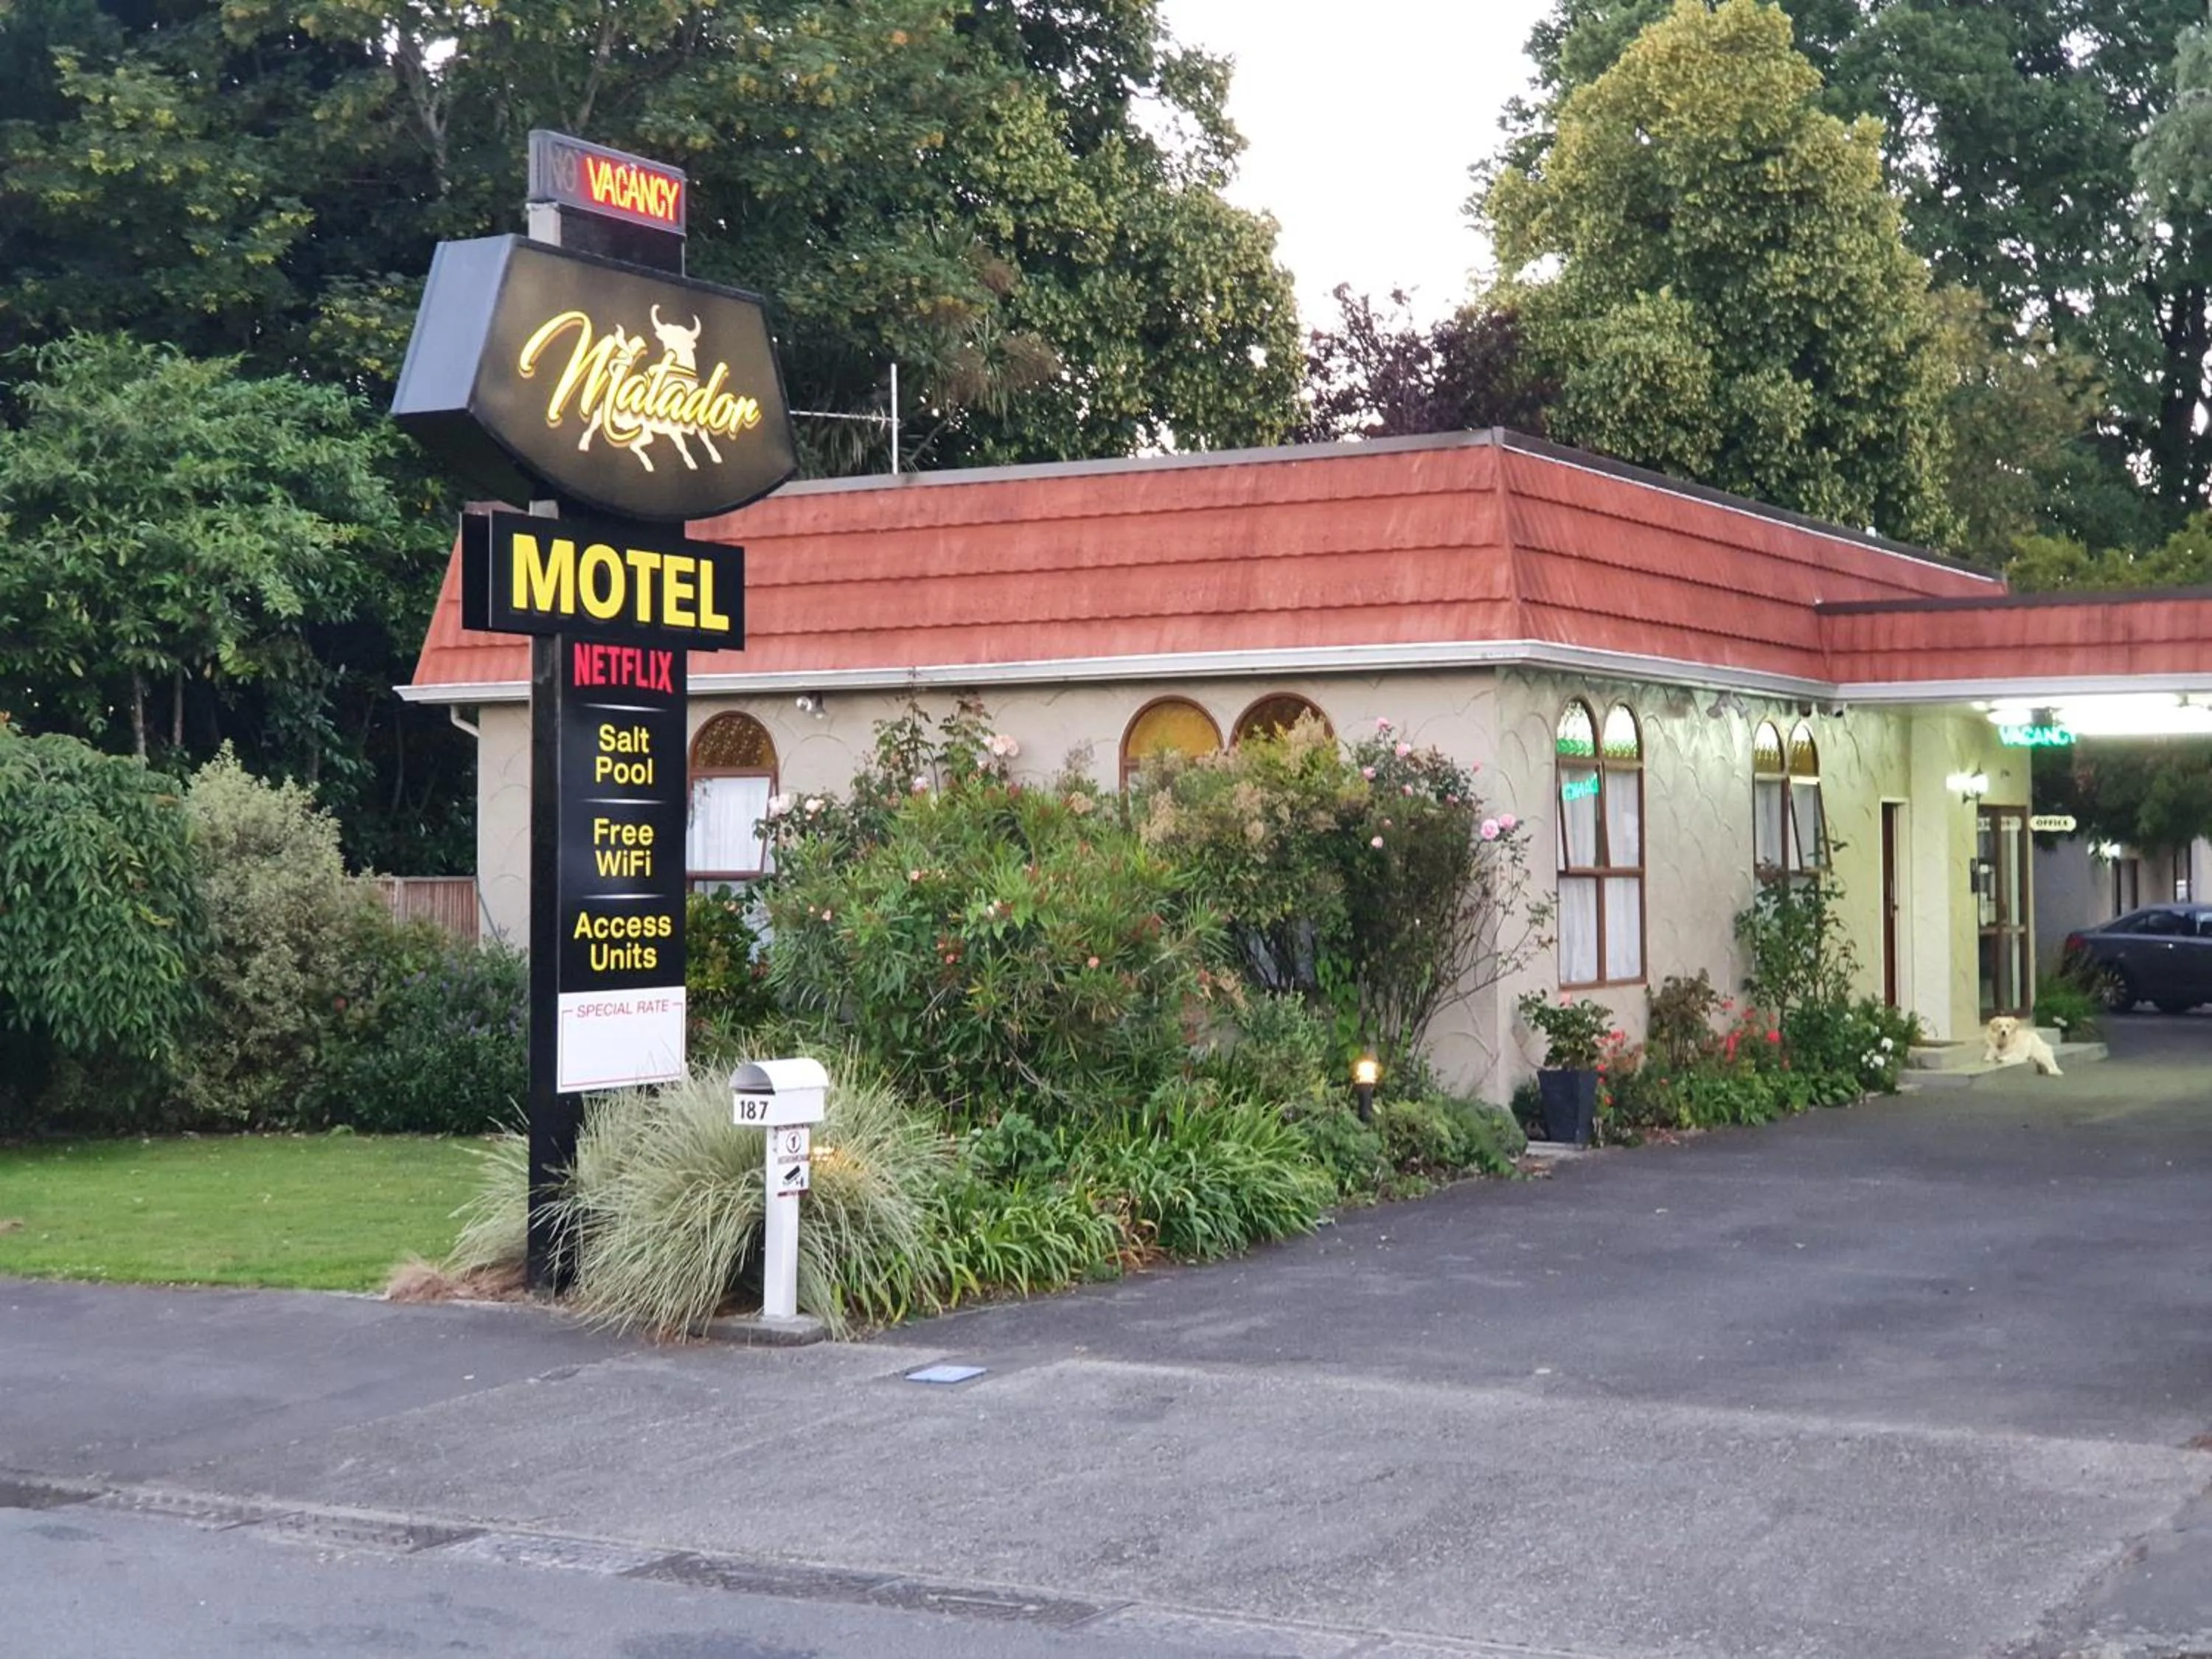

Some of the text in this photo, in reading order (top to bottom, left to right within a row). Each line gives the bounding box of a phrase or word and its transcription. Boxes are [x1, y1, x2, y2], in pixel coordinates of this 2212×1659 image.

[587, 156, 678, 220] VACANCY
[518, 310, 762, 448] Matador
[512, 533, 730, 631] MOTEL
[574, 641, 672, 693] NETFLIX
[599, 723, 650, 754] Salt
[595, 756, 653, 785] Pool
[594, 818, 654, 846] Free
[2036, 819, 2068, 827] OFFICE
[595, 849, 652, 877] WiFi
[574, 911, 672, 939] Access
[590, 942, 658, 970] Units
[577, 999, 669, 1018] SPECIAL RATE
[740, 1099, 769, 1121] 187
